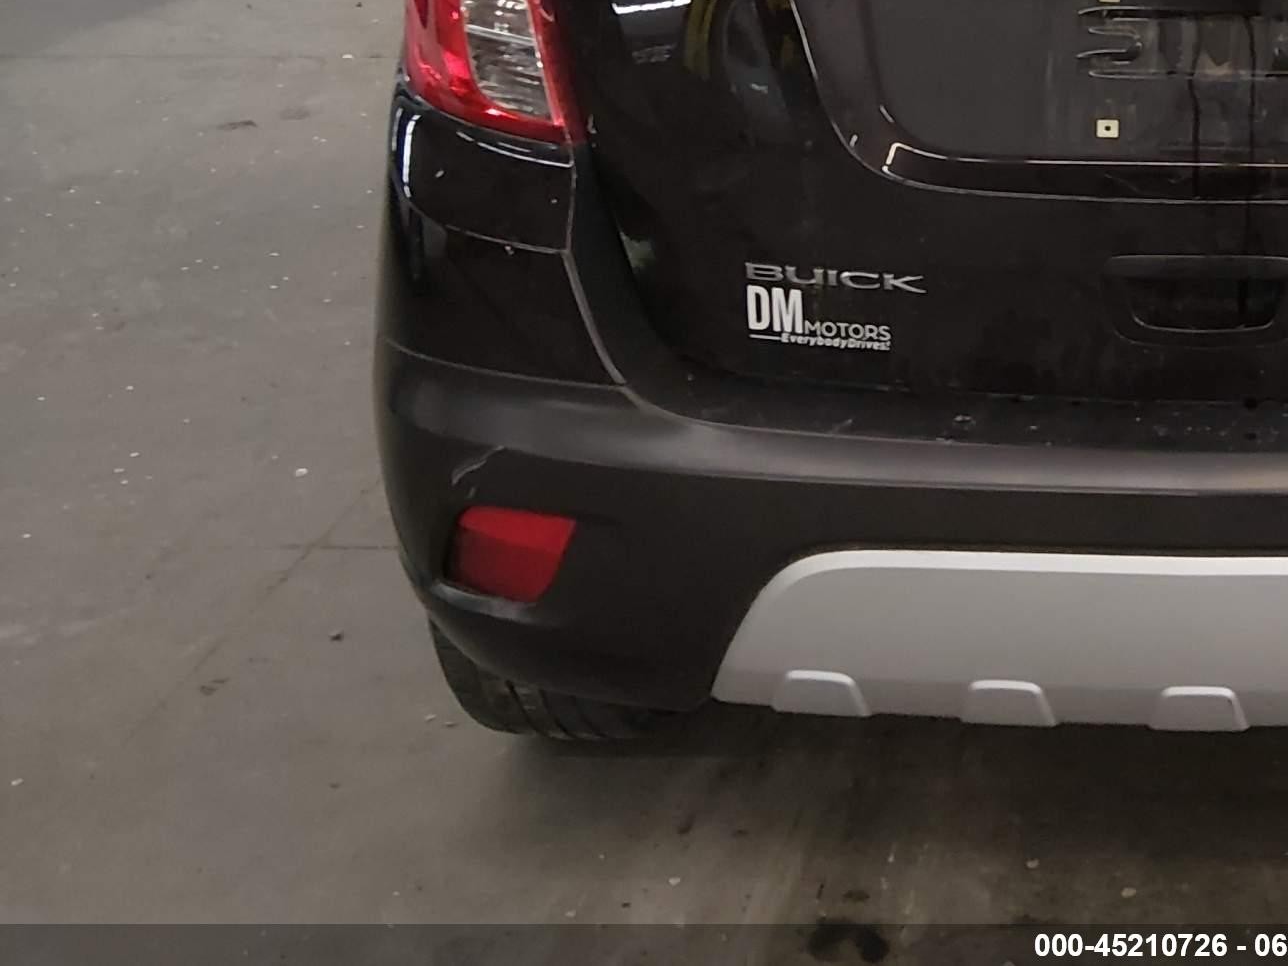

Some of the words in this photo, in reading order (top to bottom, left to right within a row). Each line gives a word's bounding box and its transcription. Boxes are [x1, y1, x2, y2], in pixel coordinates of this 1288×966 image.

[745, 262, 927, 294] BUICK
[746, 284, 803, 334] DM
[804, 320, 892, 341] MOTORS
